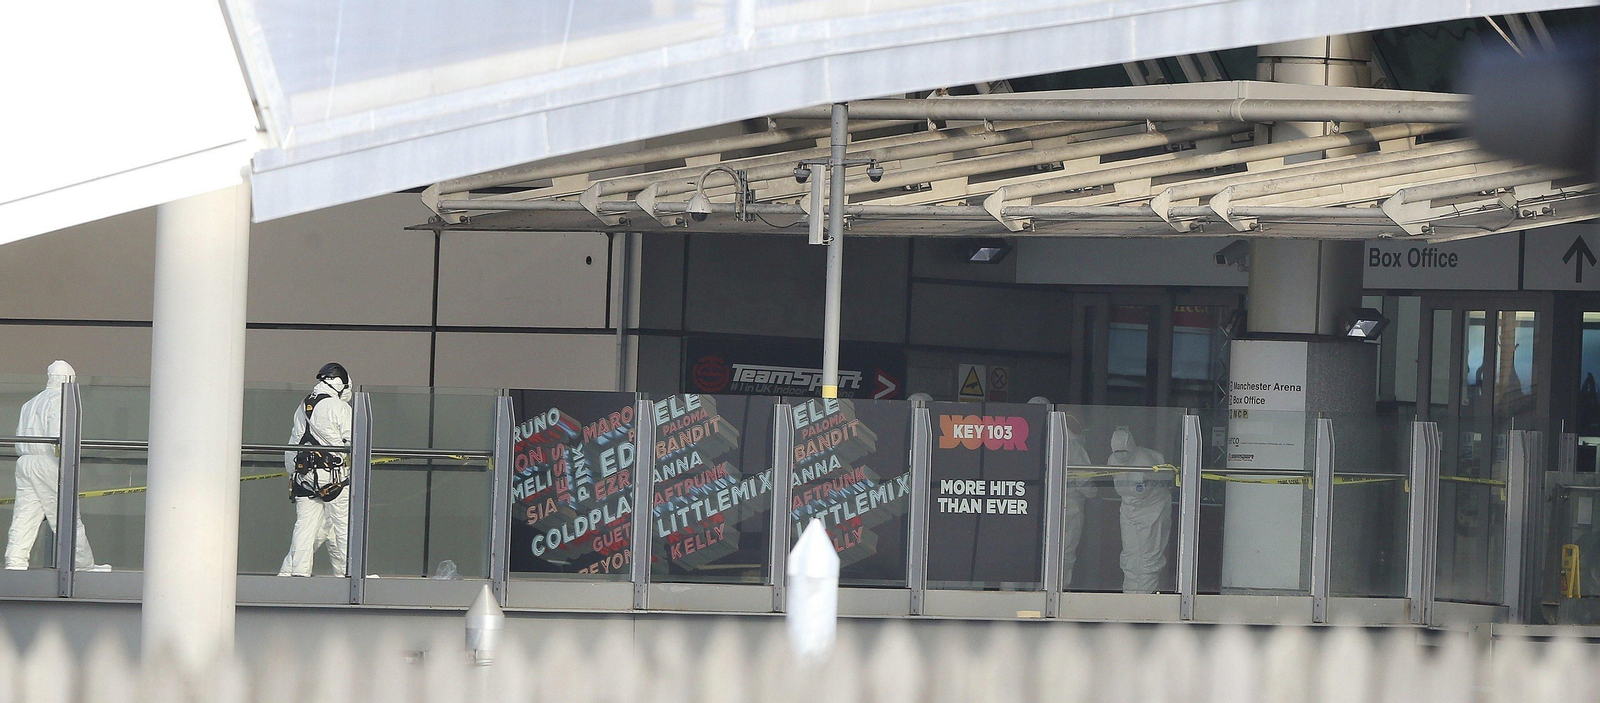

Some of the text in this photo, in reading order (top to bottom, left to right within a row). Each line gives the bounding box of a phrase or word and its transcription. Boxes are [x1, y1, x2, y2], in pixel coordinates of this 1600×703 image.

[1369, 247, 1458, 268] Box Office
[732, 363, 863, 392] TeamSprt
[755, 384, 772, 393] UK
[773, 385, 808, 395] Indoor
[1233, 381, 1302, 392] Manchester Arena
[654, 394, 701, 426] ELE
[792, 398, 841, 430] ELE
[1233, 395, 1266, 405] Box Office
[514, 407, 560, 444] RUNO
[582, 405, 634, 444] MARO
[655, 414, 721, 459] BANDIT
[662, 407, 709, 437] PALOMA
[801, 412, 847, 440] PALOMA
[953, 424, 1013, 440] KEY 103
[794, 418, 859, 463] BANDIT
[571, 441, 592, 503] PINK
[599, 442, 635, 478] ED
[653, 451, 704, 484] ANNA
[792, 454, 843, 487] ANNA
[512, 469, 553, 504] MELI
[594, 469, 632, 501] EZR
[940, 479, 1026, 497] MORE HITS
[526, 497, 559, 526] SIA
[657, 467, 772, 538] LITTLEMIX
[796, 472, 910, 539] LTTLEMIX
[937, 498, 1028, 515] THAN EVER
[531, 496, 633, 557] COLDPLA
[670, 522, 726, 560] KELLY
[833, 524, 863, 553] LLY
